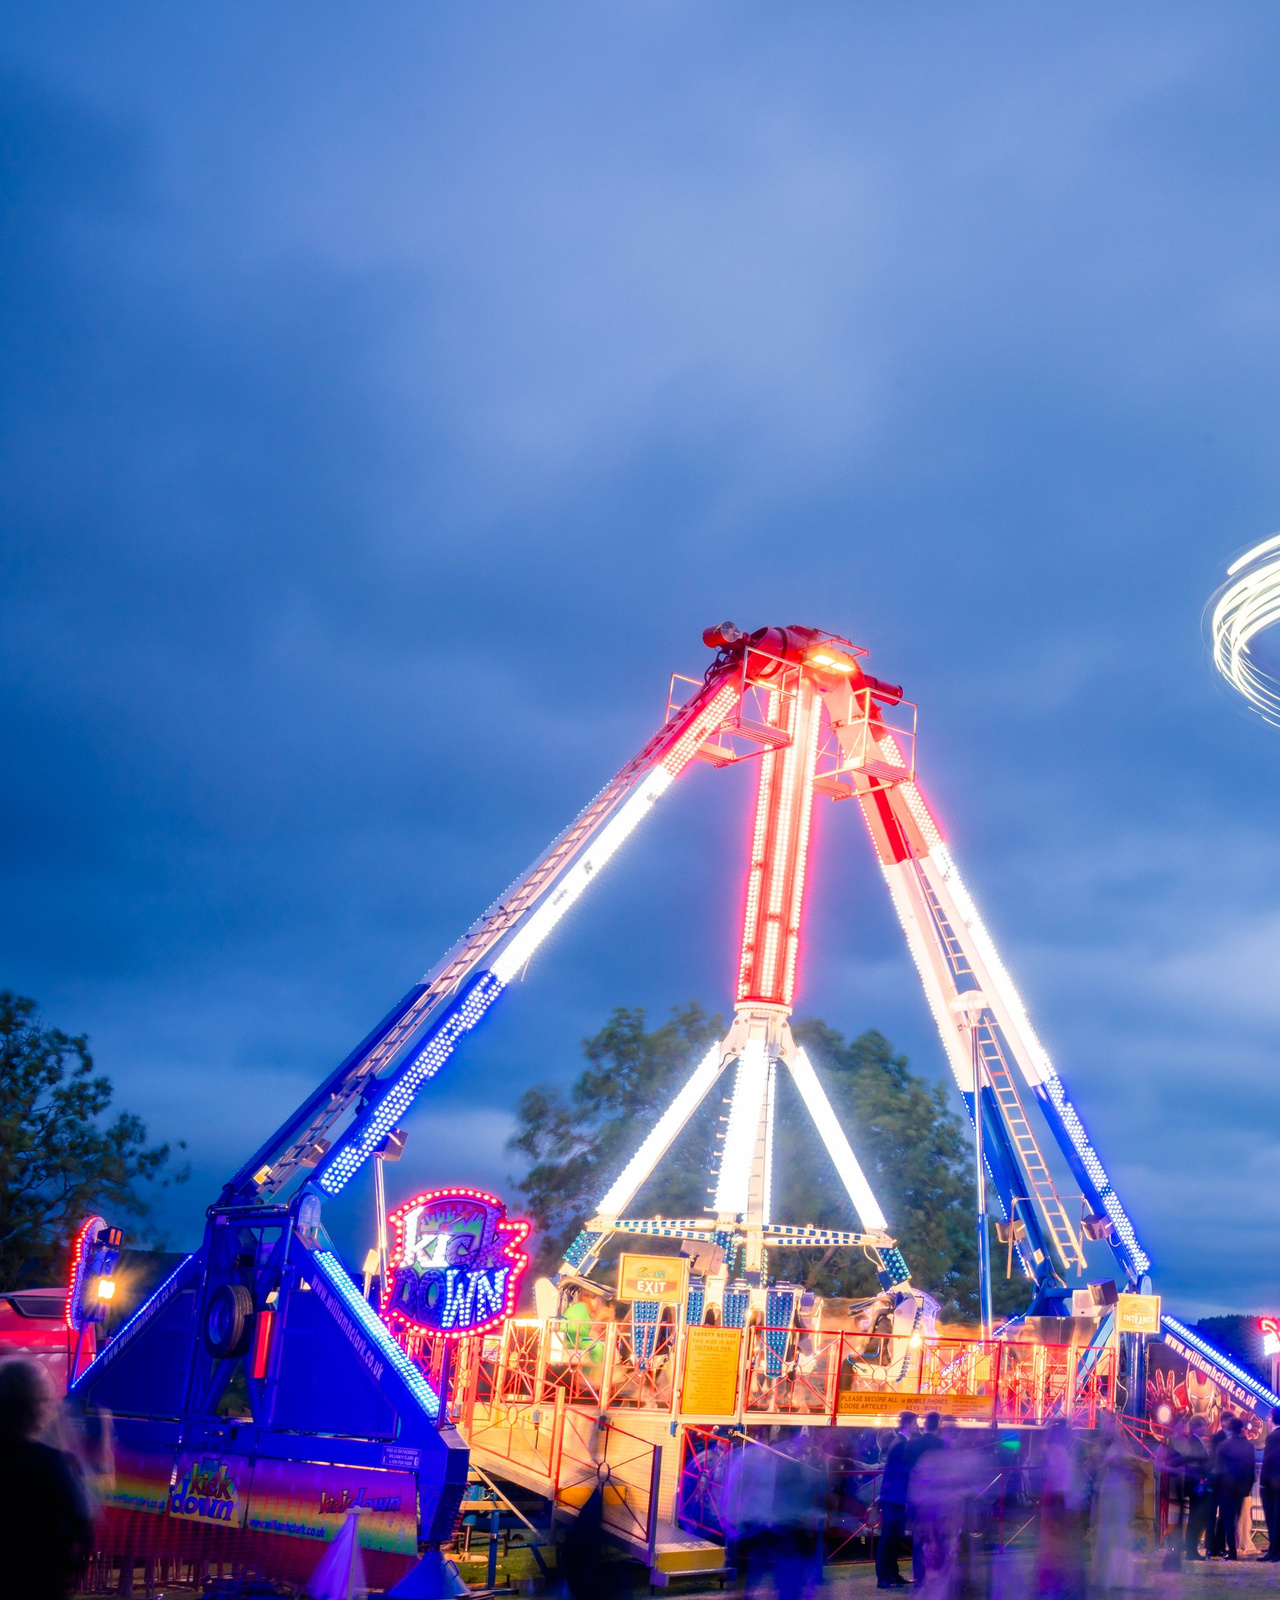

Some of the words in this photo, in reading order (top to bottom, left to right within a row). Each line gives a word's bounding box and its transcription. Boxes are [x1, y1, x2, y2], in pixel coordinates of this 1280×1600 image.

[387, 1267, 511, 1330] DOWN
[637, 1280, 666, 1296] EXIT
[312, 1274, 383, 1380] www.williamhclark.co.uk
[1123, 1314, 1155, 1325] ENTRANCE
[1164, 1333, 1258, 1409] www.williamhclark.co.uk
[170, 1479, 234, 1521] down
[190, 1462, 232, 1500] kick
